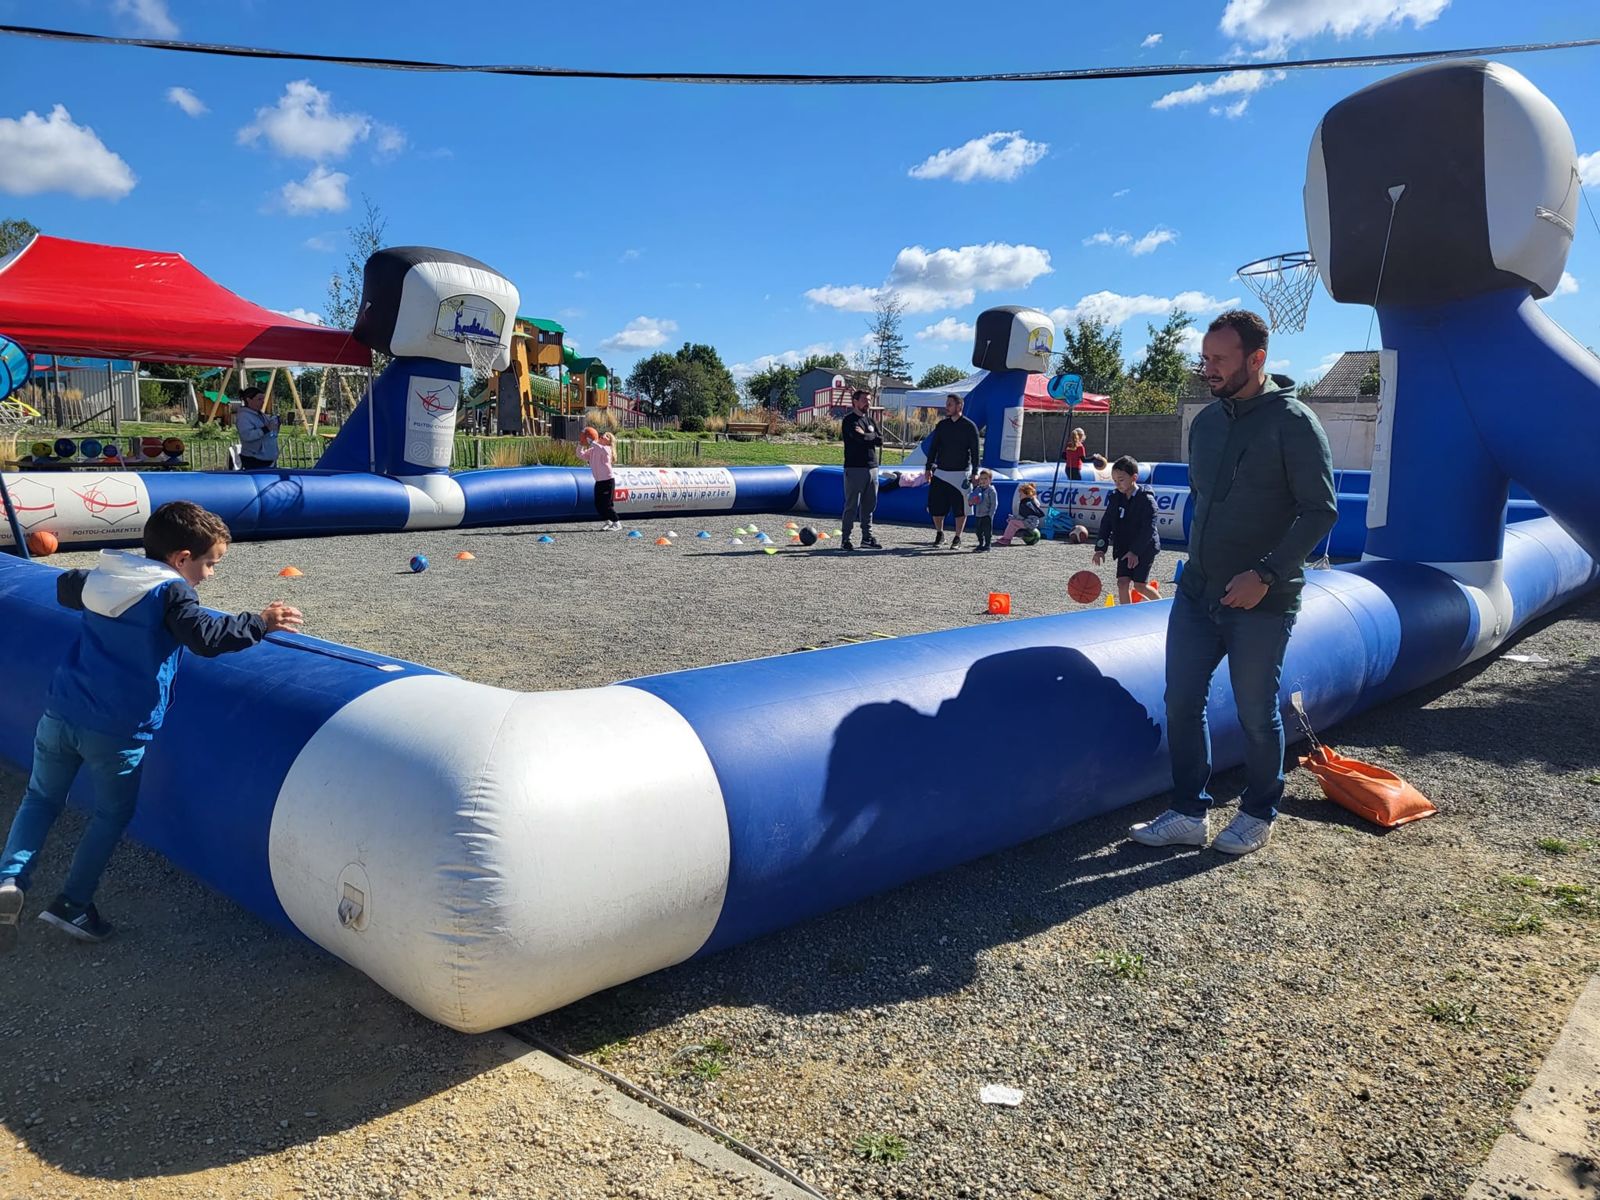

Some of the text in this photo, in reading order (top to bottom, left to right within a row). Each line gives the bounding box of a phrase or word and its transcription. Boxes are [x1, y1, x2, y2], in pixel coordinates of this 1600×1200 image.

[674, 470, 729, 485] Mutuel
[615, 490, 627, 499] LA
[631, 490, 668, 501] banque
[681, 490, 697, 500] qui
[700, 488, 730, 498] parler
[1037, 487, 1079, 504] rédit
[73, 527, 141, 536] POITOU-CHARENTES
